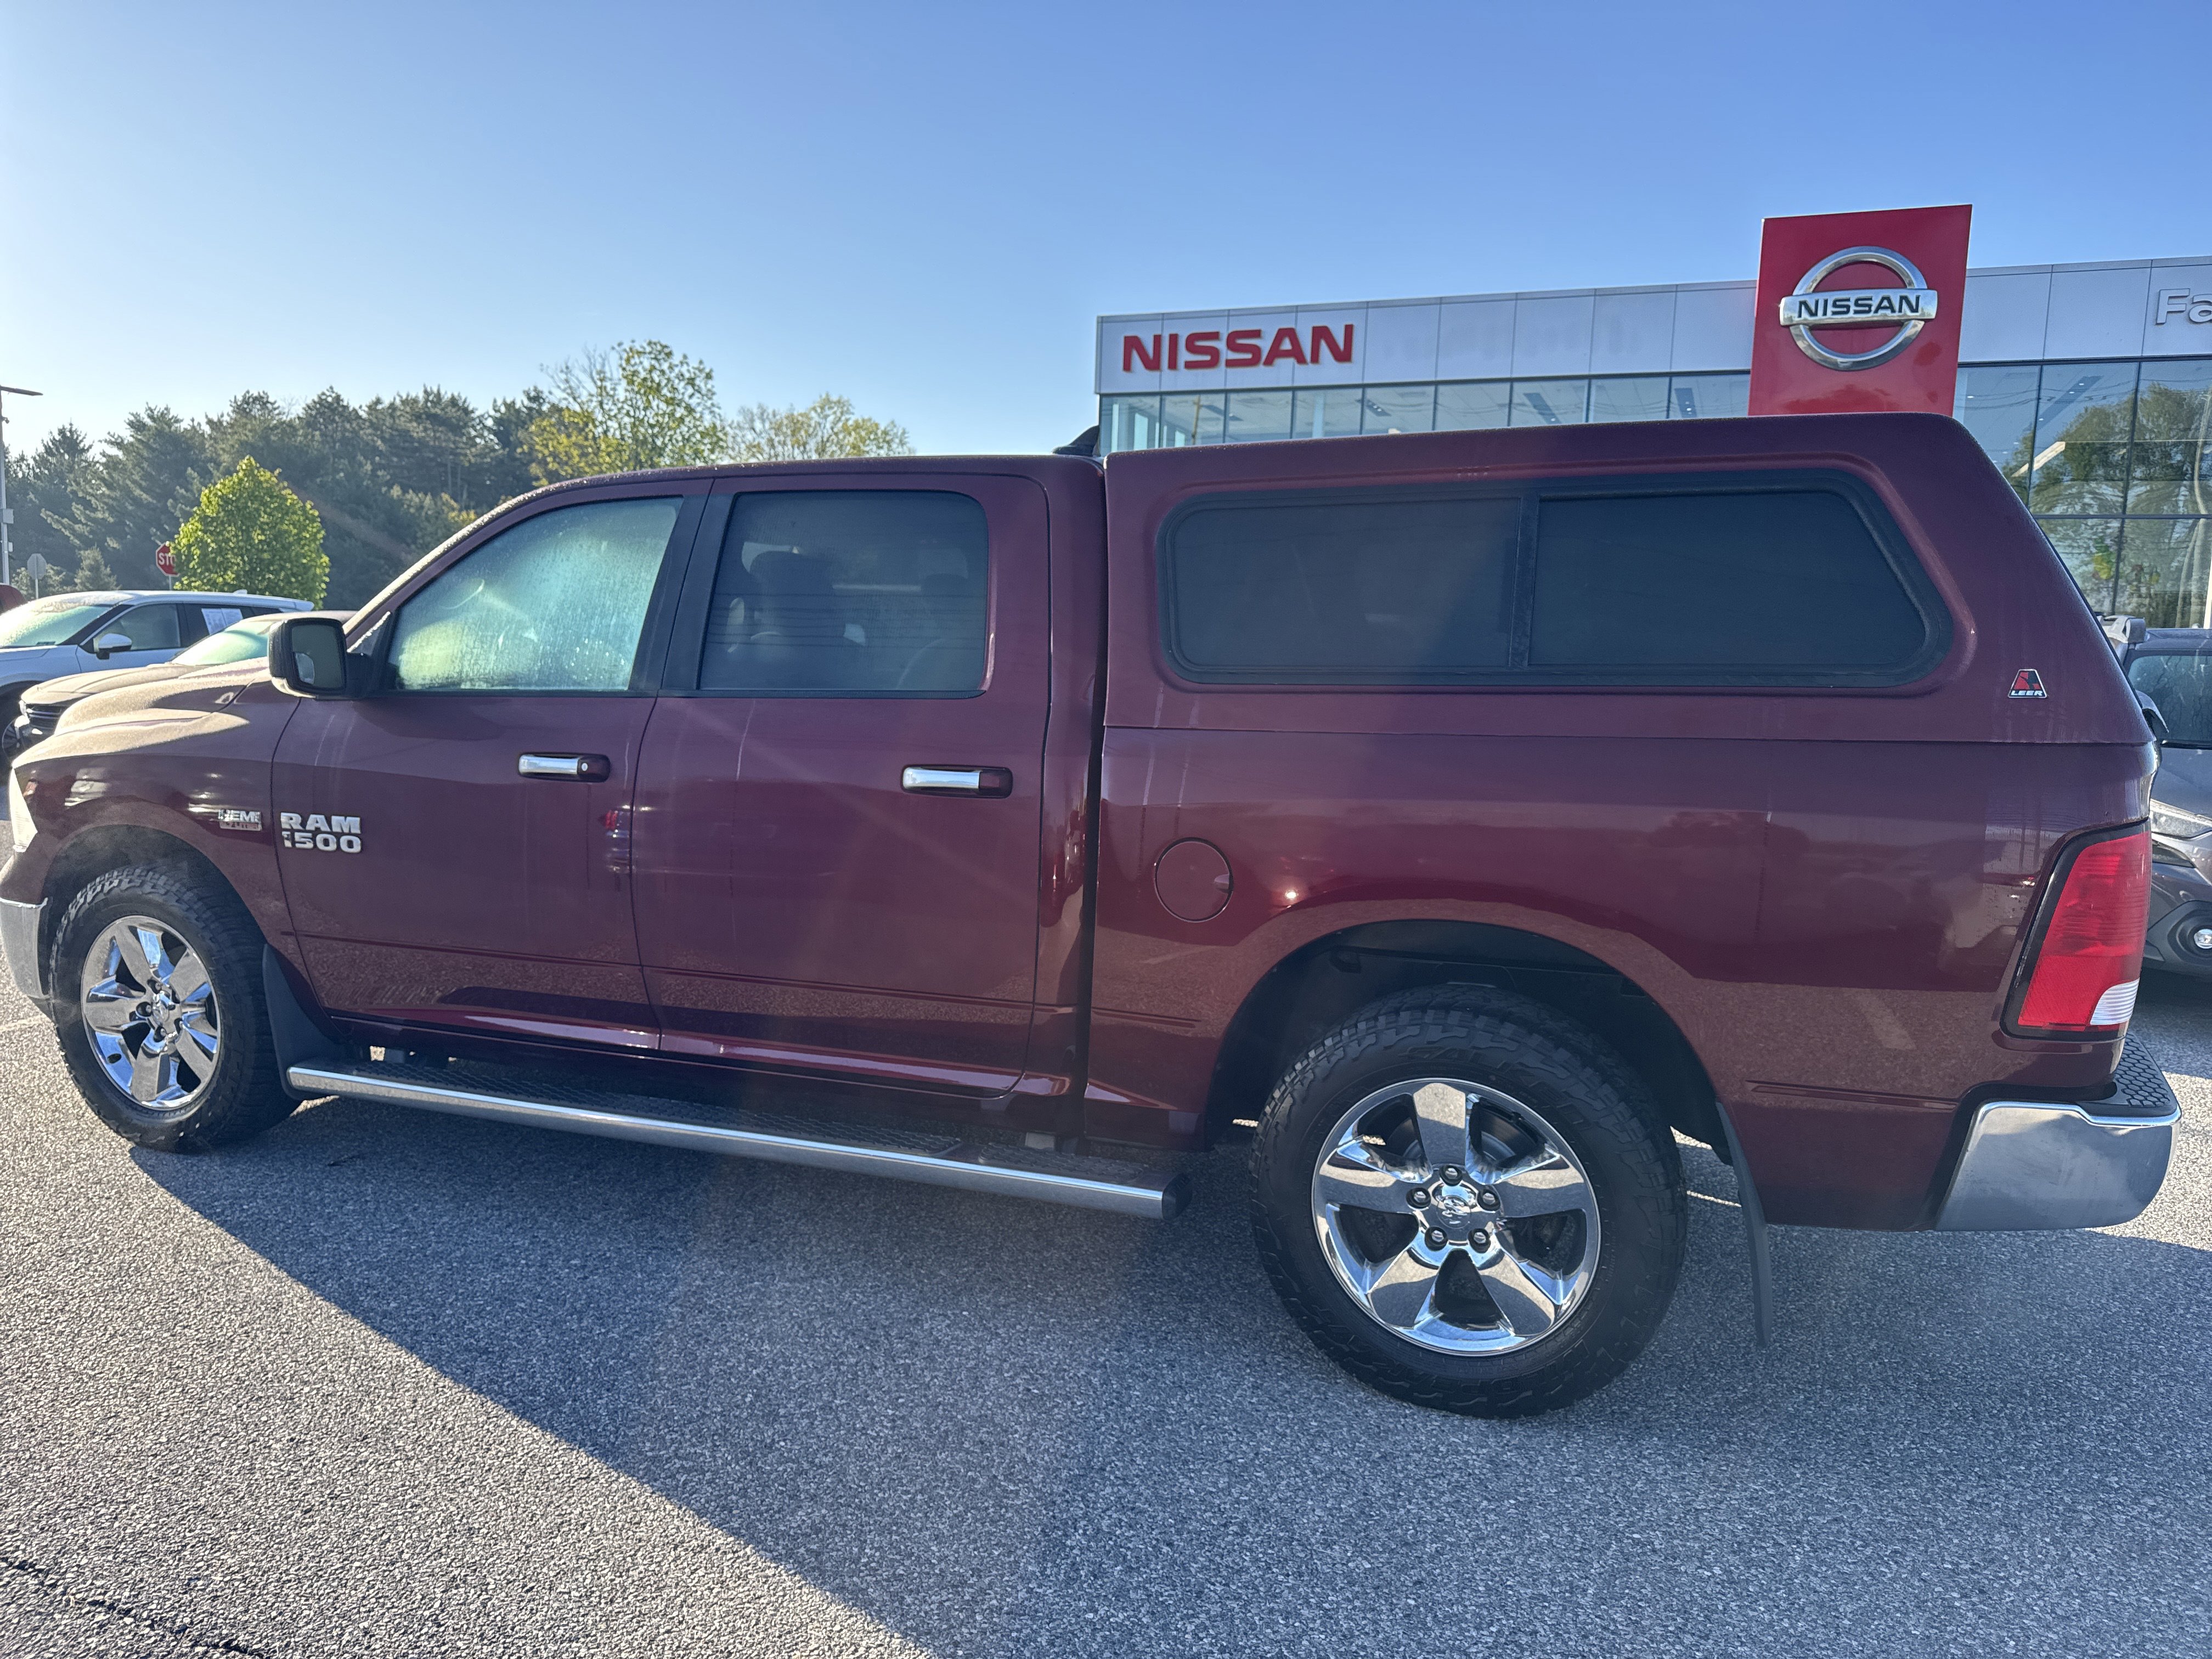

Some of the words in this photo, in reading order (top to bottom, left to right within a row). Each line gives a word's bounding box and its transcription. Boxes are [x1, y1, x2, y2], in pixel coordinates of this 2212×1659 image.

[1797, 295, 1921, 318] NISSAN
[1122, 324, 1355, 372] NISSAN
[159, 552, 176, 566] STO
[280, 812, 361, 834] RAM
[281, 831, 362, 853] 1500
